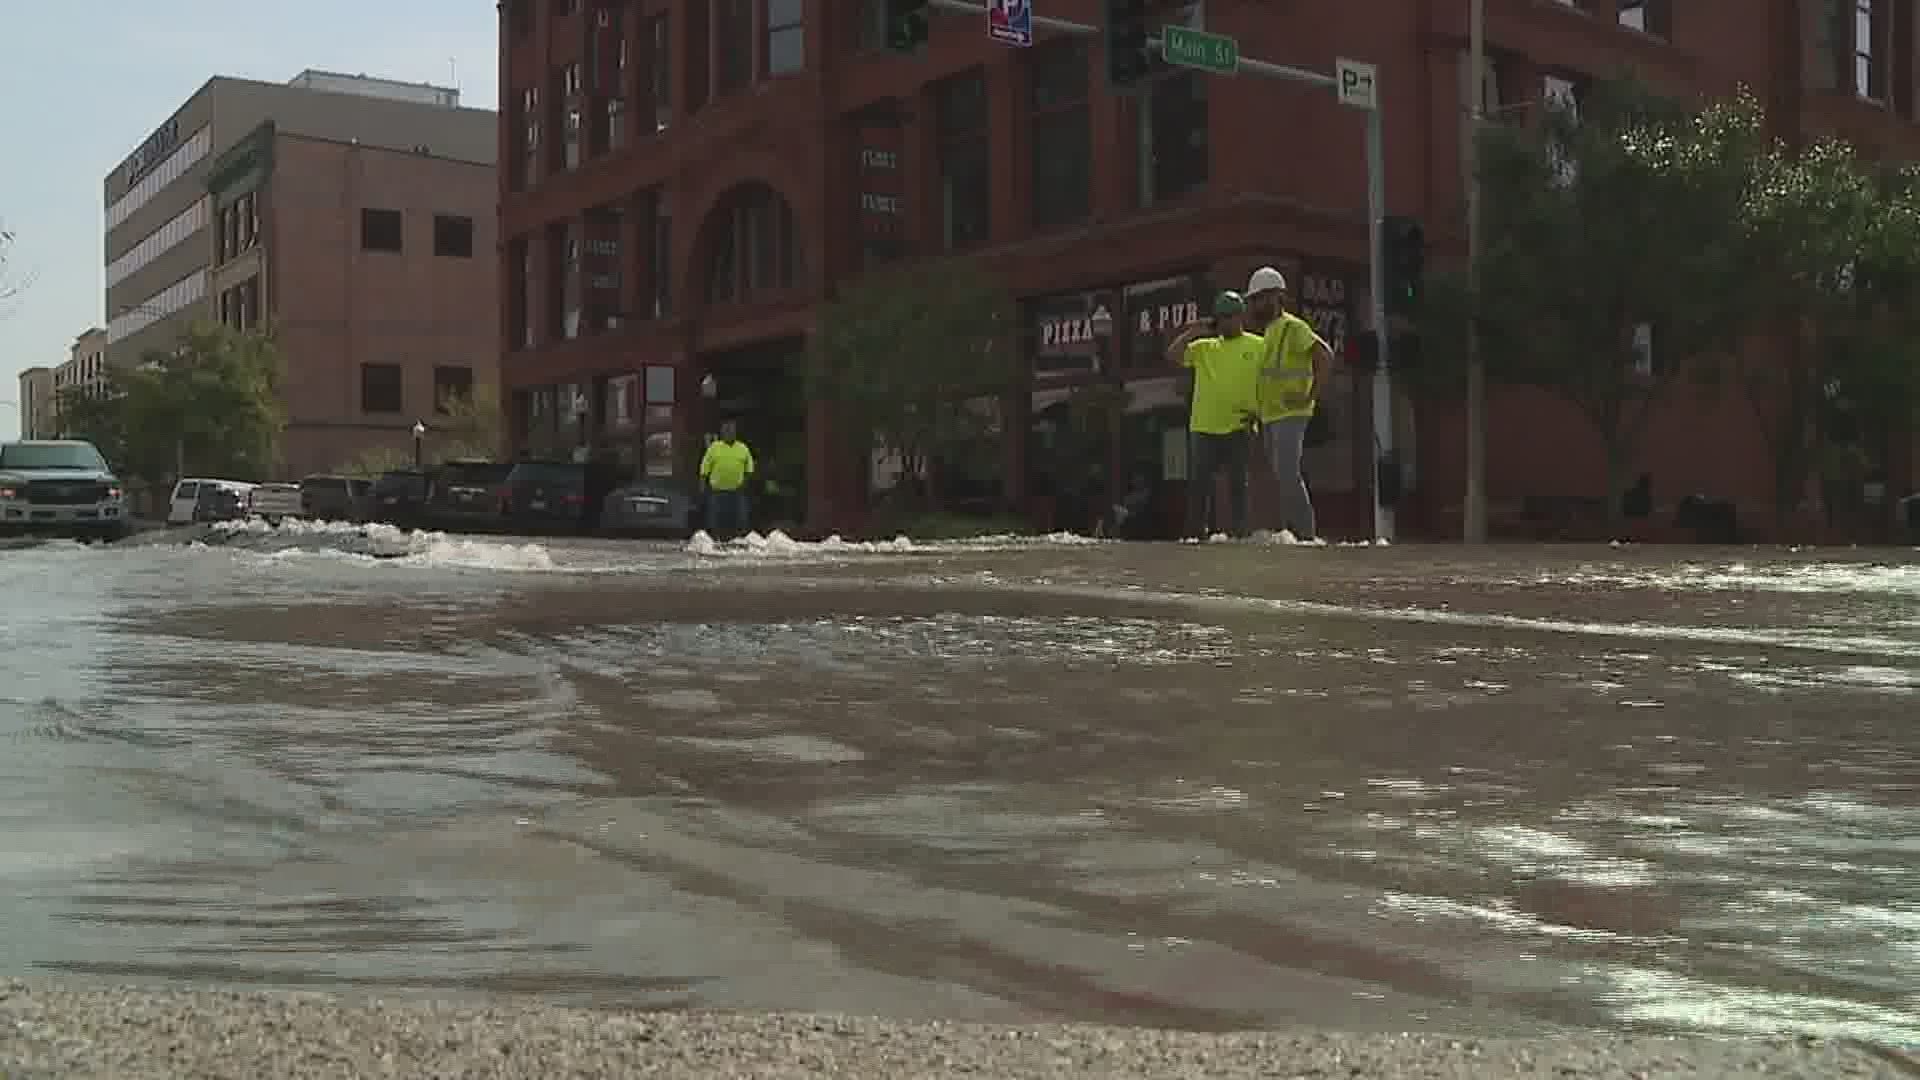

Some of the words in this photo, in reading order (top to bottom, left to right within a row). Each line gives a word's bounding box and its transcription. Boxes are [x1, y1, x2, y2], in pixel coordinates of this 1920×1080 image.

[1170, 32, 1207, 60] Main
[1215, 41, 1231, 65] St
[1343, 69, 1358, 97] P
[1159, 302, 1200, 330] PUB
[1042, 319, 1094, 345] PIZZA
